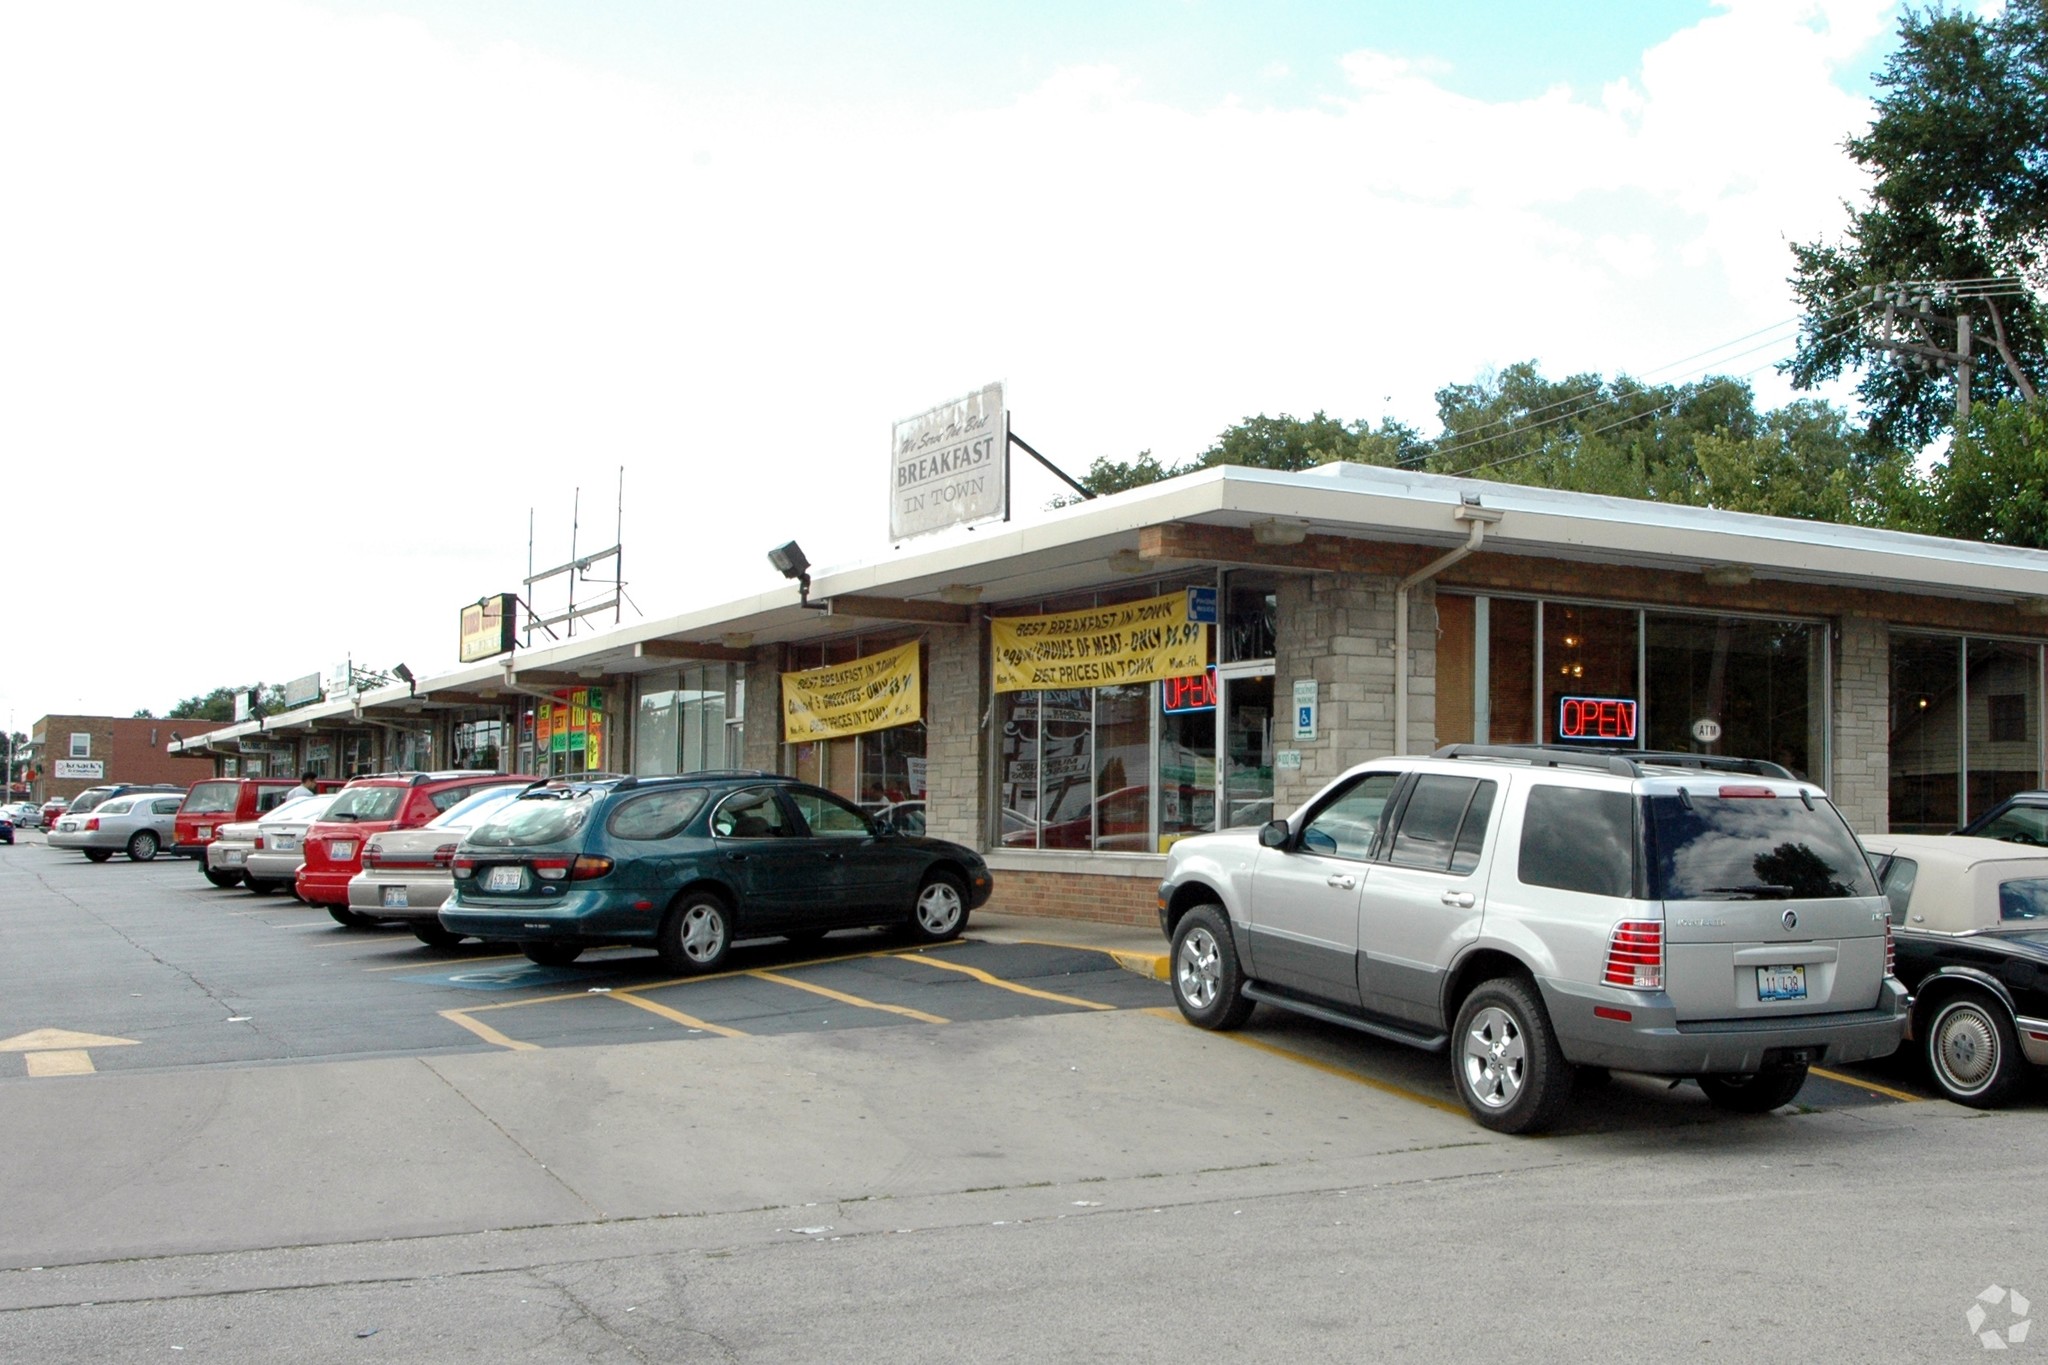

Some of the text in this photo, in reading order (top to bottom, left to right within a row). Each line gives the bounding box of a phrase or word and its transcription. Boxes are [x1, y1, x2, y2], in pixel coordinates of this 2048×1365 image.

[918, 431, 944, 450] Serve
[945, 422, 961, 441] The
[964, 413, 990, 435] Best
[897, 437, 994, 488] BREAKFAST
[903, 476, 985, 515] IN TOWN
[1015, 600, 1175, 638] BEST BREAKFAST IN TOWN
[1076, 636, 1092, 658] OF
[1092, 630, 1122, 657] MEAT
[1130, 626, 1162, 653] ONLY
[797, 677, 820, 692] BEST
[820, 667, 863, 689] BREAKFAST
[865, 663, 875, 678] IN
[1031, 655, 1155, 684] BEST PRICES IN TOWN
[1164, 667, 1217, 709] OPEN
[1296, 696, 1314, 705] PARKING
[829, 714, 853, 730] PRICES
[853, 710, 864, 726] IN
[864, 704, 890, 723] TOWN
[1562, 699, 1636, 737] OPEN
[1698, 723, 1718, 737] ATM
